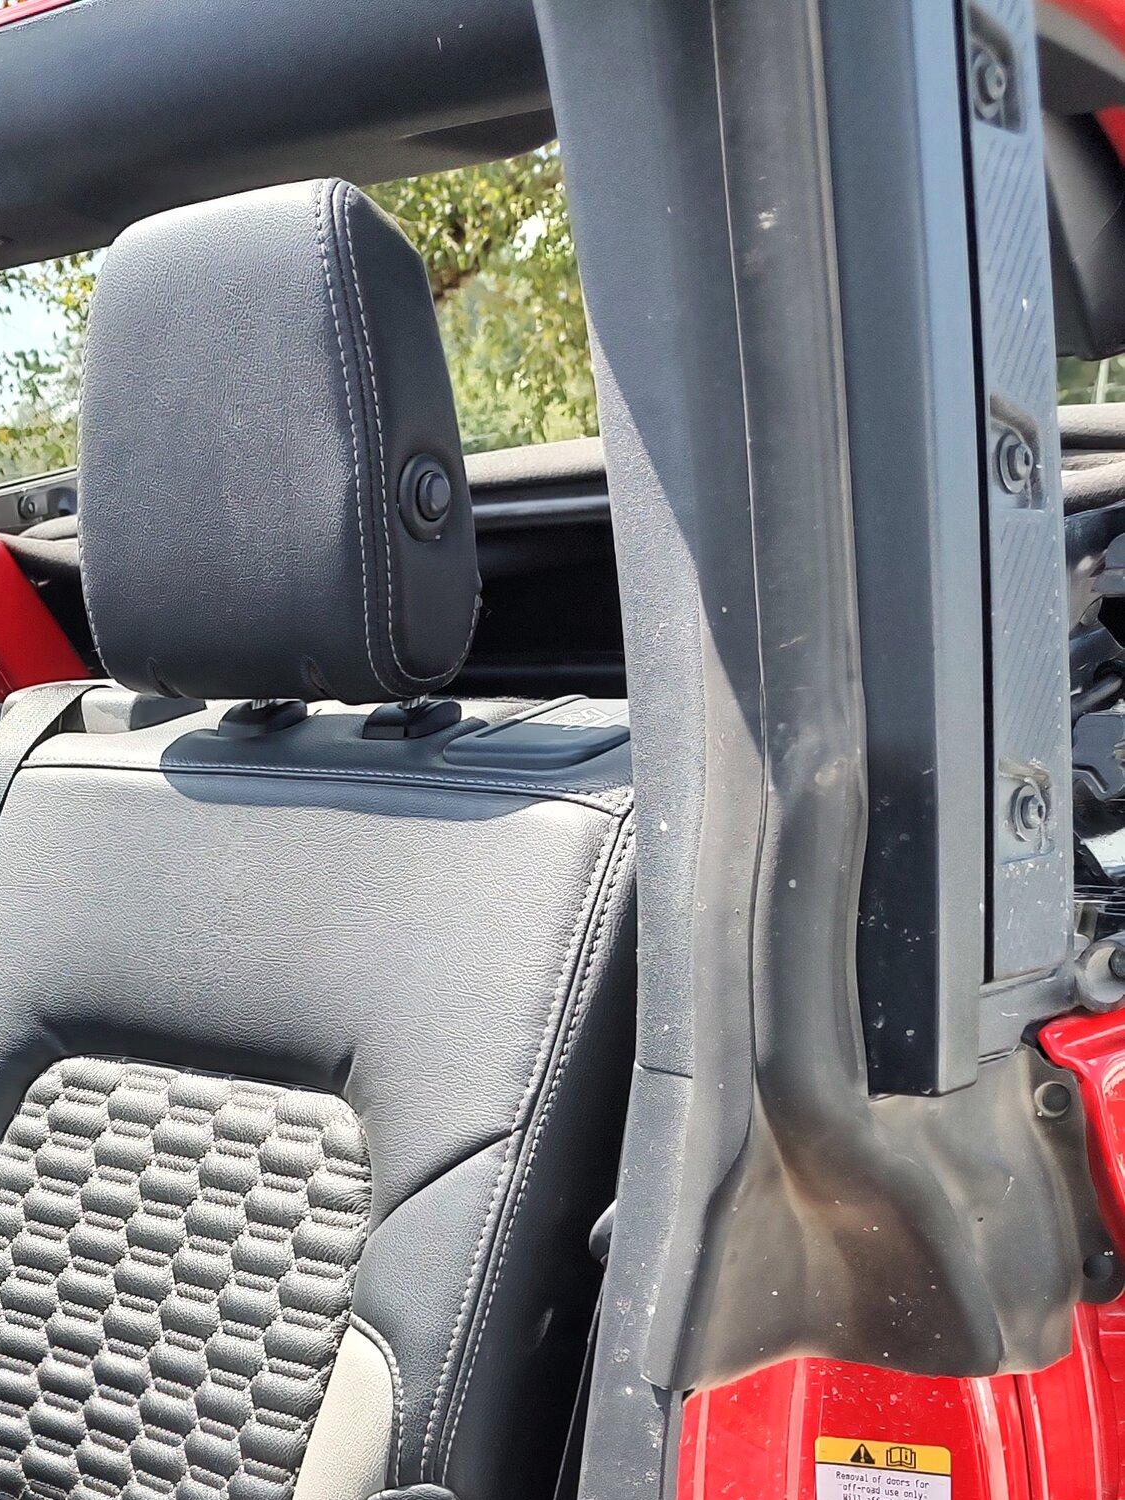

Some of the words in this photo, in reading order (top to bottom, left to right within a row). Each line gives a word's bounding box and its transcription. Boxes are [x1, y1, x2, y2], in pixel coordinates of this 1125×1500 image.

[836, 1471, 868, 1483] Removal
[873, 1476, 881, 1484] of
[886, 1477, 910, 1487] doors
[916, 1480, 929, 1489] for
[843, 1483, 880, 1495] off-road
[884, 1488, 899, 1497] use
[903, 1490, 928, 1500] only.
